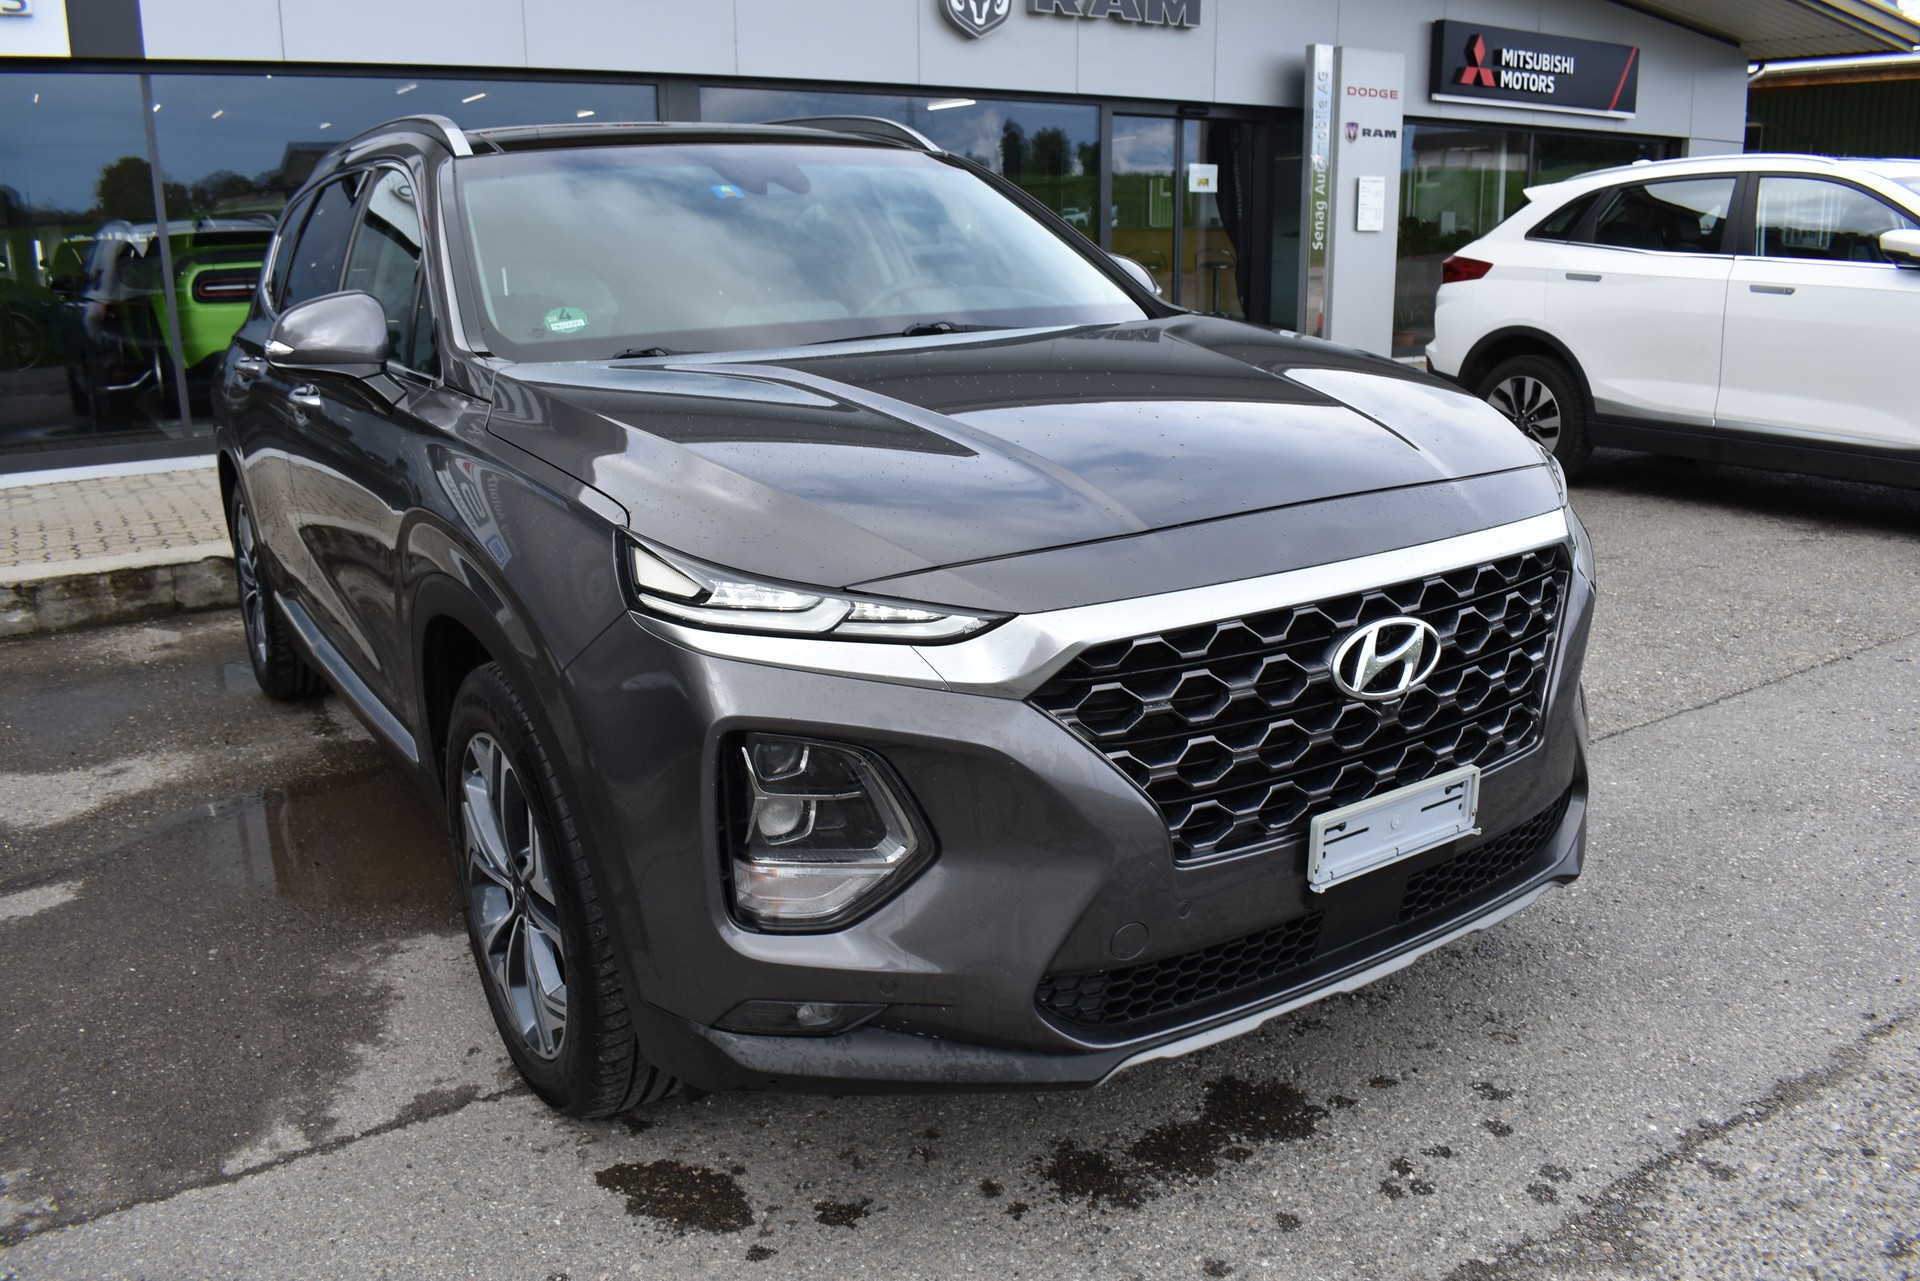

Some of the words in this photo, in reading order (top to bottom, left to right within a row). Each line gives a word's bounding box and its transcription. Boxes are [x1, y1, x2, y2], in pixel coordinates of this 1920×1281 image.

[1502, 48, 1574, 75] MITSUBISHI
[1318, 71, 1329, 94] AG
[1347, 86, 1399, 100] DODGE
[1500, 70, 1555, 93] MOTORS
[1361, 128, 1397, 139] RAM
[1312, 200, 1328, 250] Senag
[559, 308, 572, 320] 4
